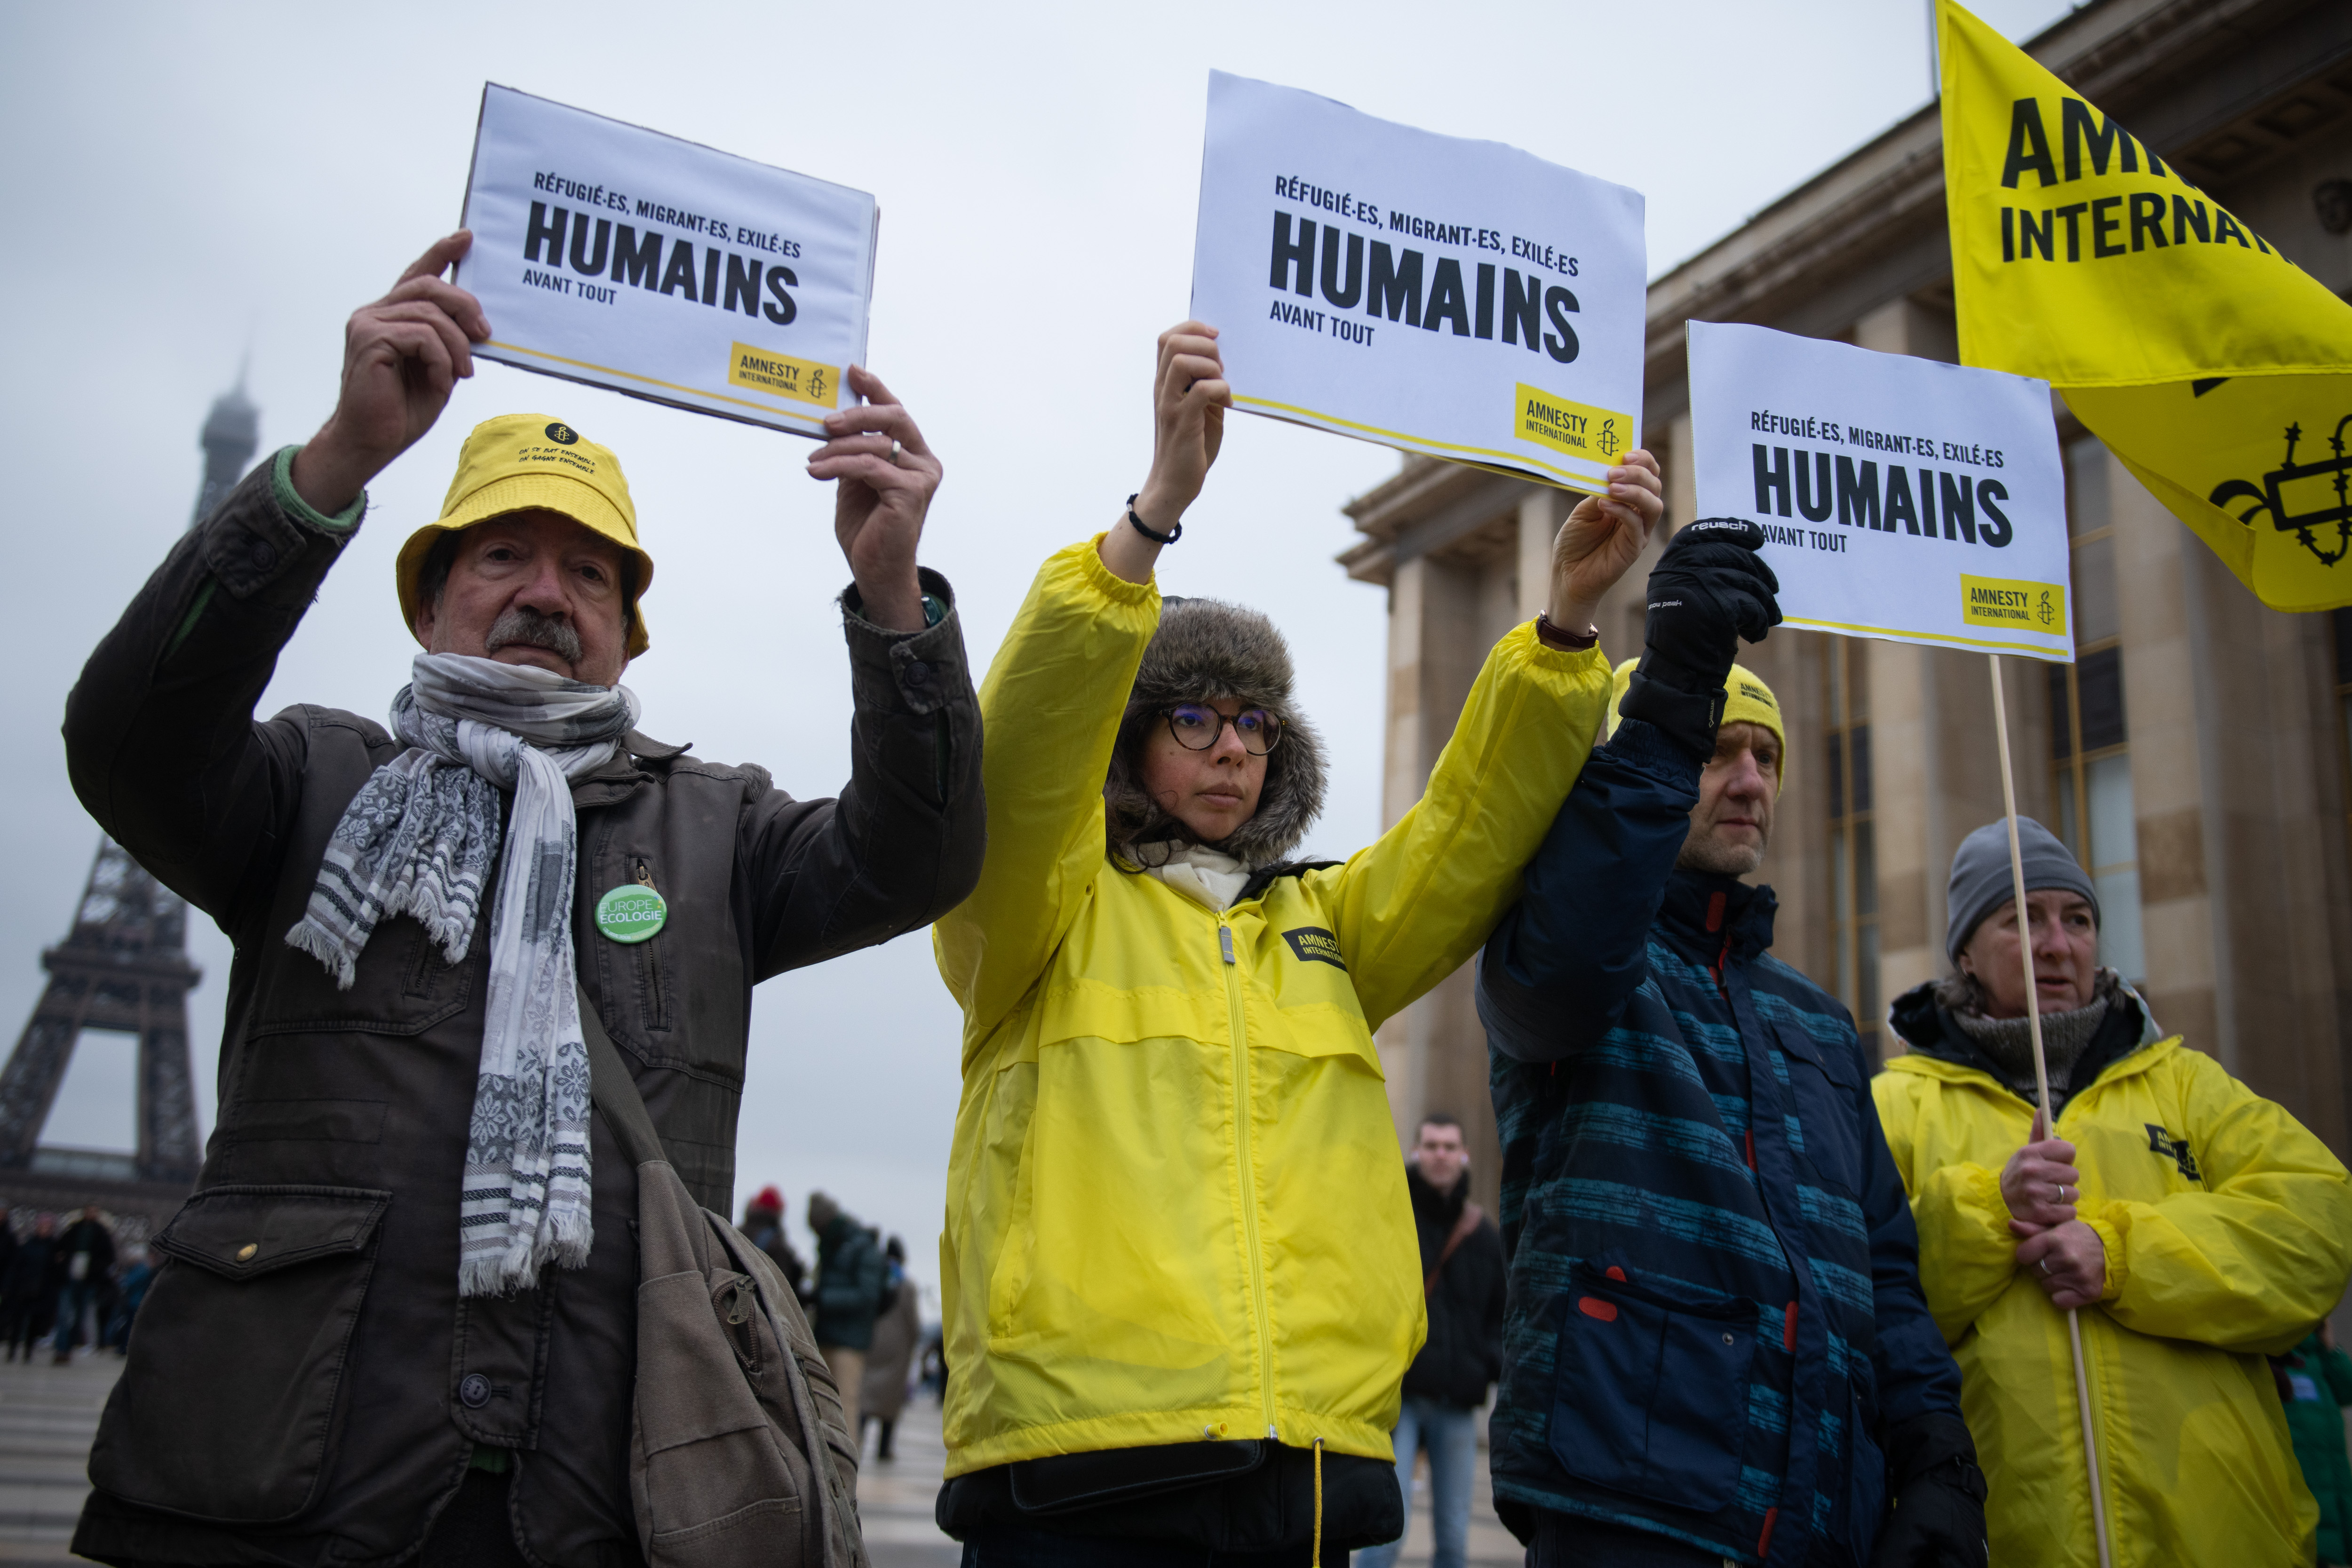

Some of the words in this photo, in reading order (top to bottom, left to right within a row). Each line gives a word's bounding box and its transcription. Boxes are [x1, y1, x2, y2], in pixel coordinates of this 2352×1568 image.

[2001, 192, 2295, 266] INTERNA
[524, 200, 799, 326] HUMAINS
[523, 268, 572, 294] AVANT
[578, 282, 617, 305] TOUT
[1269, 210, 1580, 364] HUMAINS
[1270, 300, 1326, 333] AVANT
[1330, 316, 1375, 347] TOUT
[739, 370, 797, 392] INTERNATIONAL
[740, 355, 799, 380] AMNESTY
[1526, 399, 1588, 434] AMNESTY
[1526, 419, 1588, 449] INTERNATIONAL
[1752, 443, 2013, 548] HUMAINS
[1691, 521, 1748, 532] reusch
[1762, 524, 1804, 547] AVANT
[1809, 531, 1847, 553] TOUT
[1661, 600, 1682, 608] peak
[1971, 587, 2028, 608] AMNESTY
[1971, 606, 2031, 621] INTERNATIONAL
[600, 899, 653, 913] EUROPE
[600, 910, 663, 924] ECOLOGIE
[1298, 934, 1339, 953] AMNEST
